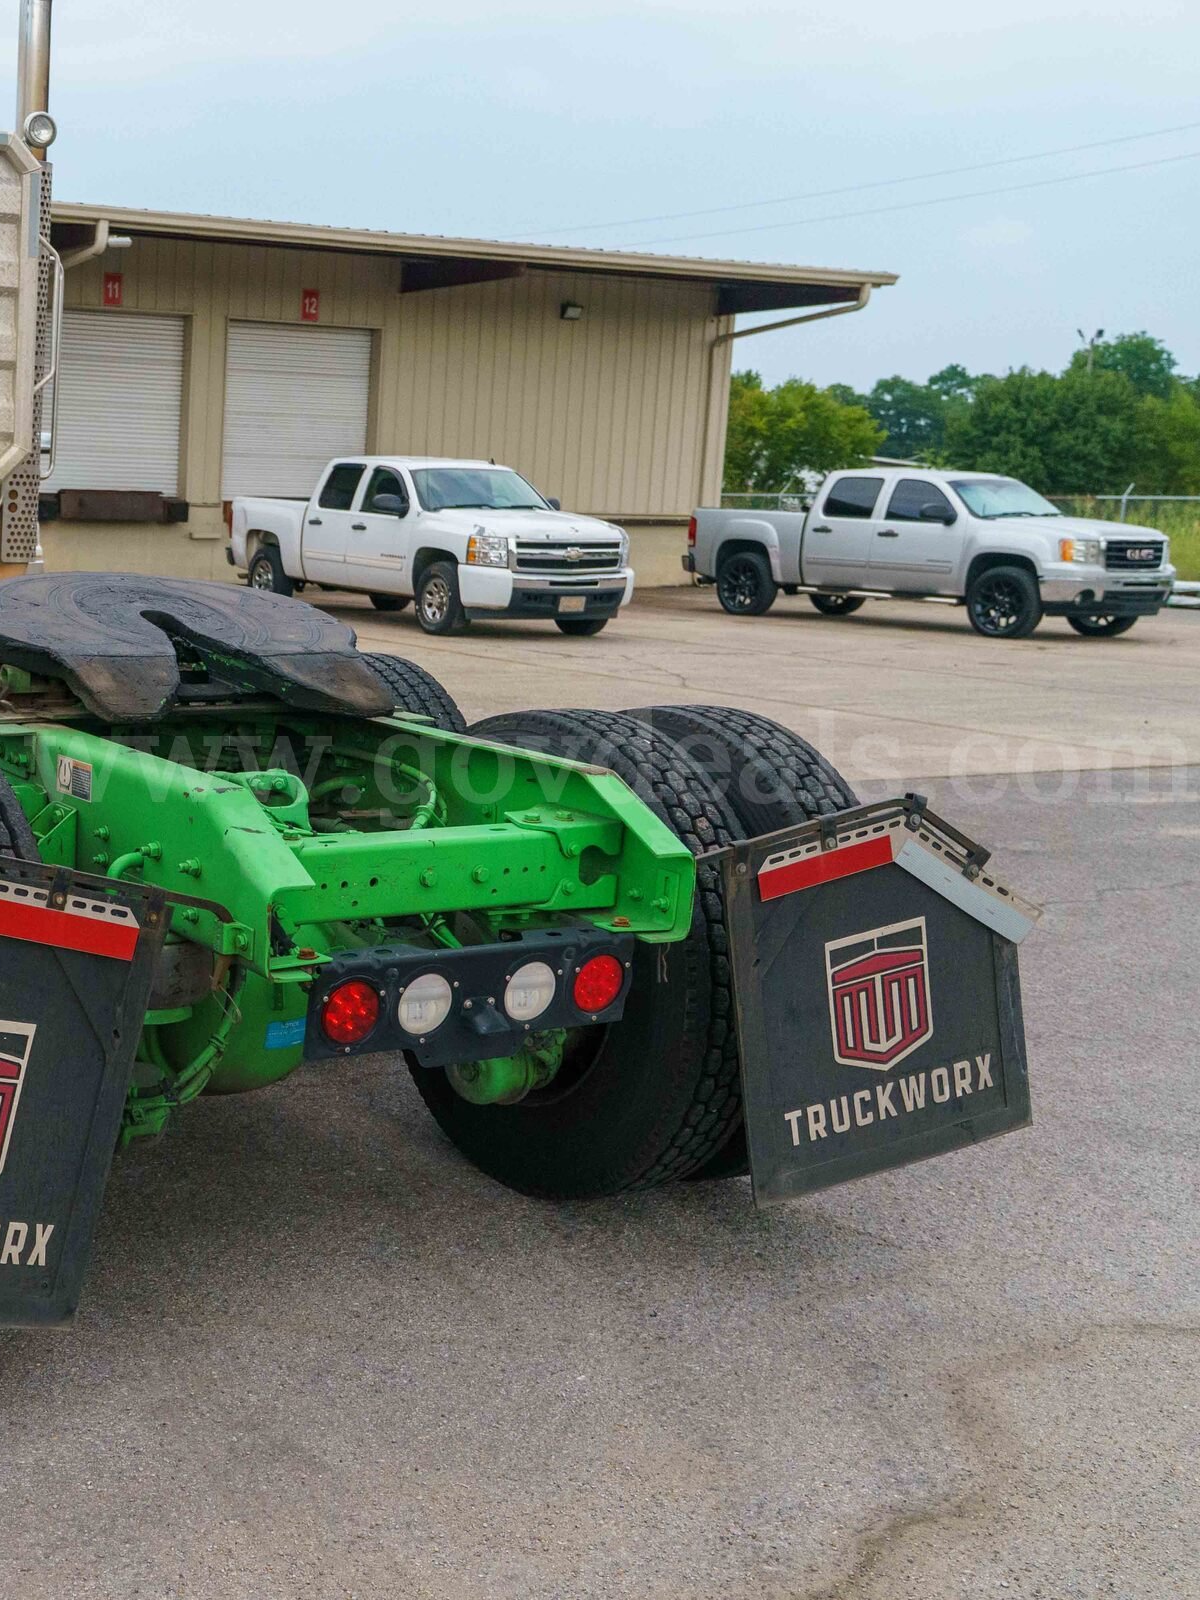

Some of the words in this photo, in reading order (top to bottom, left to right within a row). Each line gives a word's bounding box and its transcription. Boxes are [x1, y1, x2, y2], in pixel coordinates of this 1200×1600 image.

[106, 280, 119, 299] 11
[304, 297, 317, 314] 12
[784, 1053, 994, 1147] TRUCKWORX
